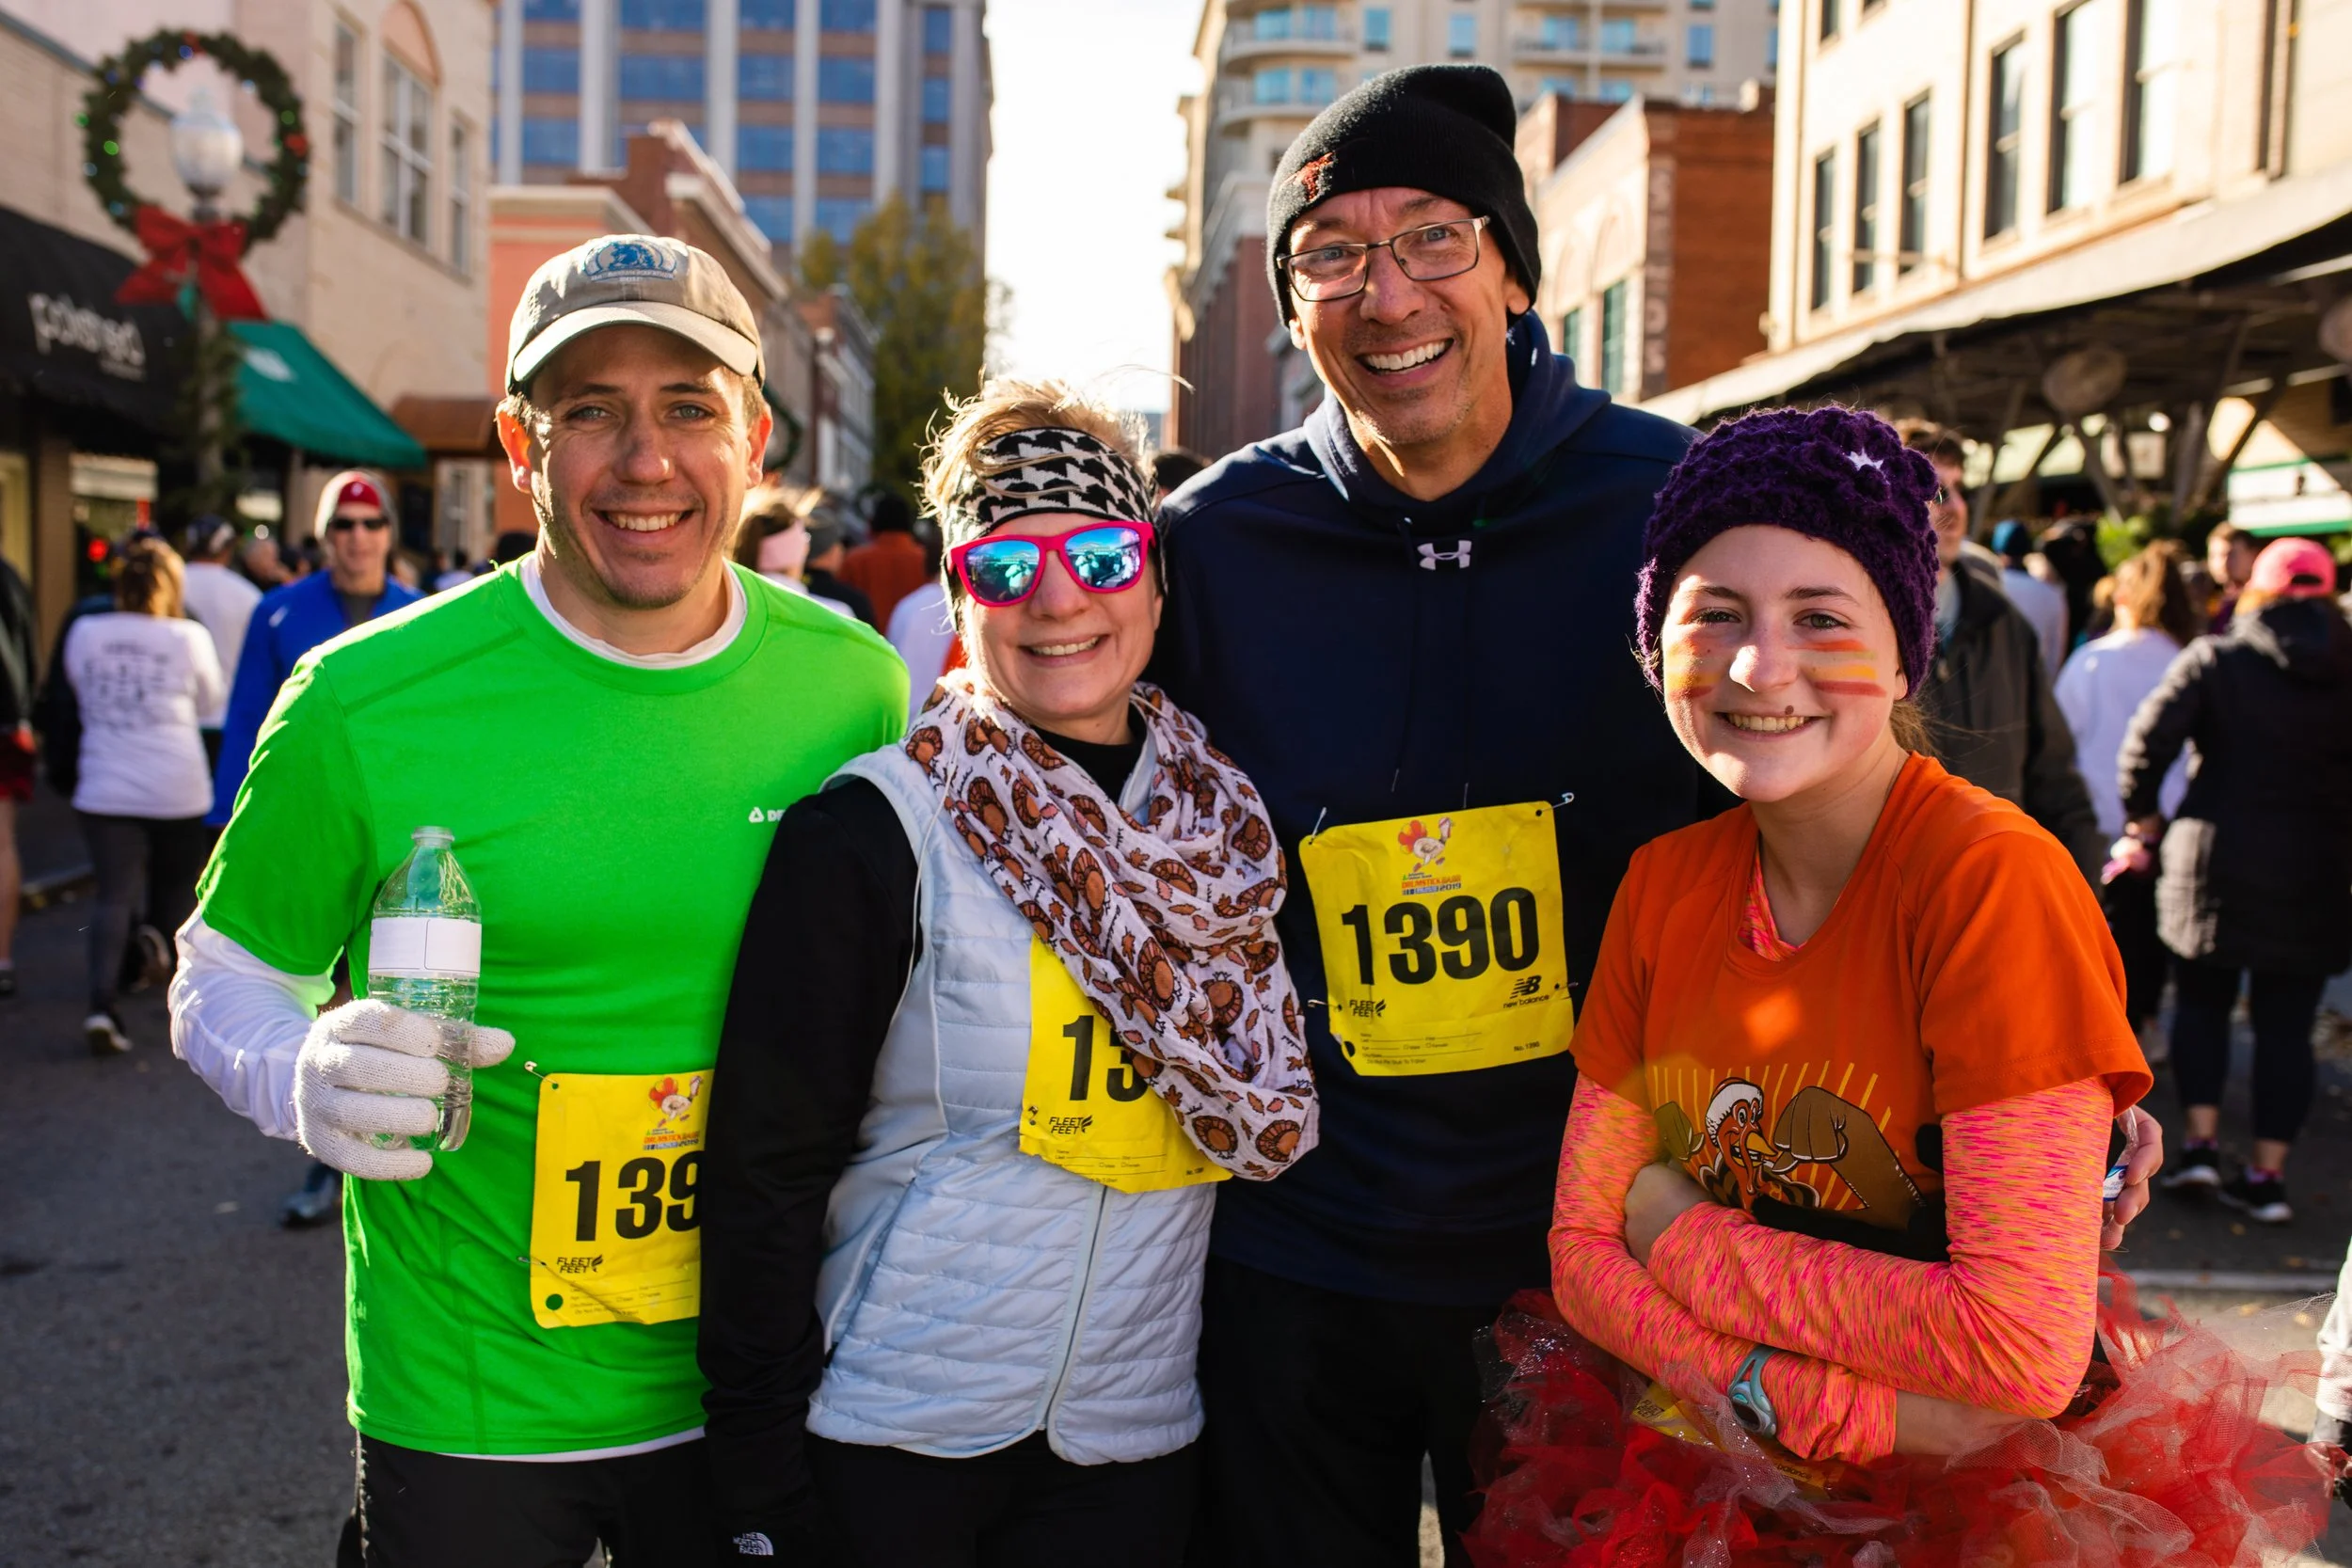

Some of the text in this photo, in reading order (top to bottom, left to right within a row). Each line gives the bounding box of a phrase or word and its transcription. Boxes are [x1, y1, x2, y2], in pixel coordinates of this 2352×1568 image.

[1342, 887, 1539, 986] 1390
[1349, 999, 1375, 1009] FLEET
[1519, 994, 1549, 1006] balance
[1353, 1007, 1374, 1017] FEET
[1049, 1117, 1084, 1126] FLEET
[1051, 1125, 1080, 1134] FEET
[557, 1257, 593, 1267] FLEET
[560, 1265, 587, 1274] FEET
